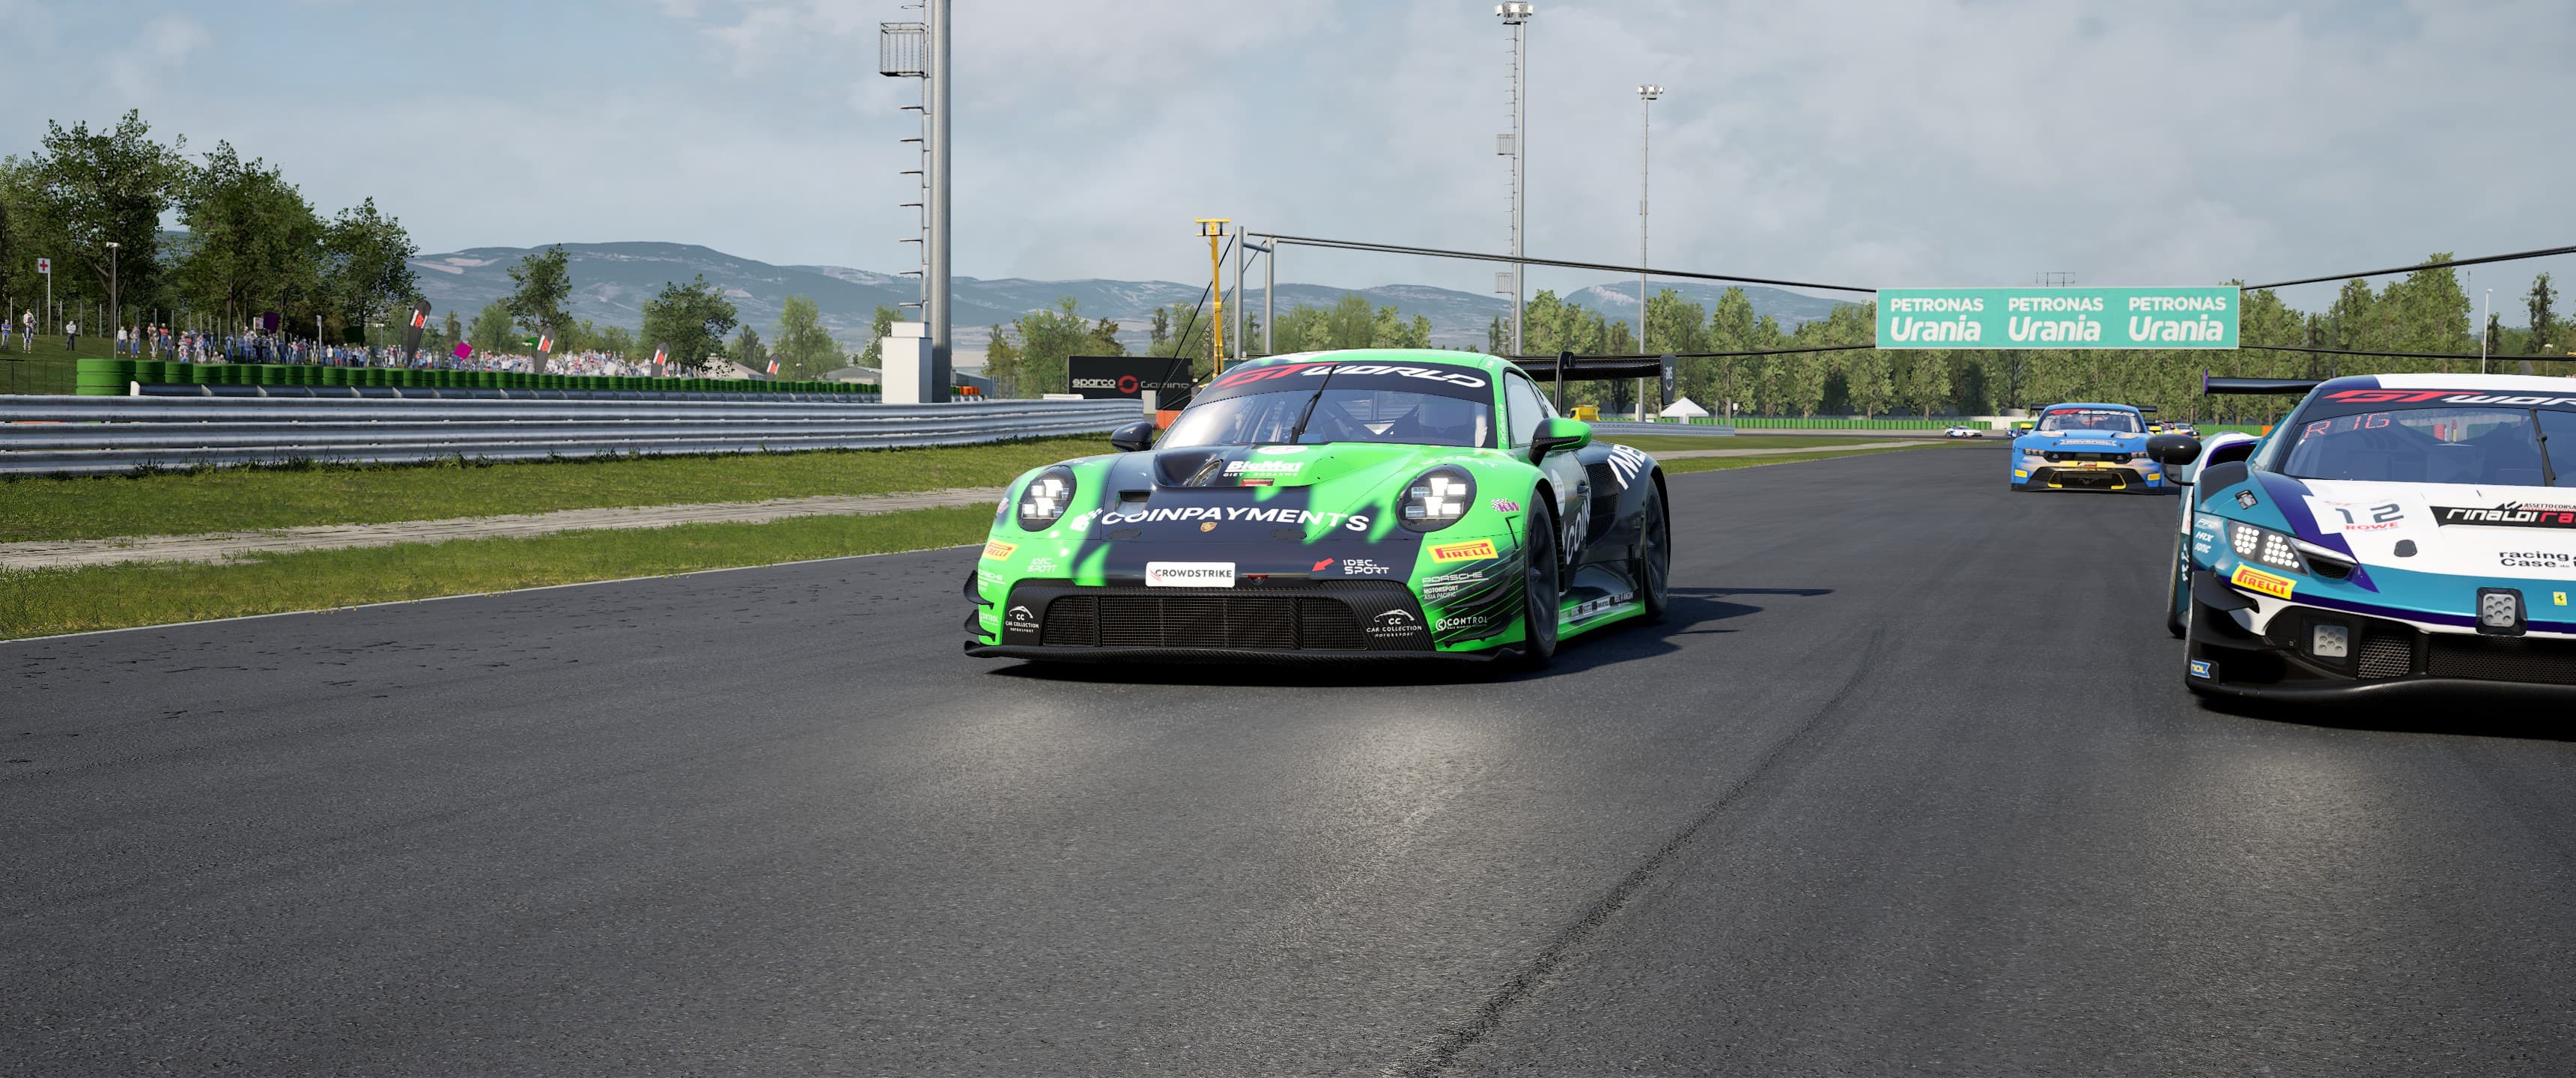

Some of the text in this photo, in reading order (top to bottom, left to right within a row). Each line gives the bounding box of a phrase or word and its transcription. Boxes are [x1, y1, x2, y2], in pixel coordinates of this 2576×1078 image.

[1891, 297, 1984, 312] PETRONAS
[2008, 297, 2103, 312] PETRONAS
[2129, 296, 2226, 311] PETRONAS
[1890, 314, 1981, 342] Urania
[2008, 314, 2102, 342] Urania
[2129, 314, 2224, 342] Urania
[1301, 365, 1486, 388] WORLD
[1101, 507, 1370, 532] COINPAYMENTS
[2335, 503, 2405, 524] 12
[2539, 512, 2576, 524] ra
[2345, 523, 2399, 531] ROWE
[1434, 543, 1492, 559] PIRELLI
[2499, 551, 2569, 562] racing
[1344, 566, 1390, 575] SPORT
[2500, 558, 2556, 568] Case
[1155, 568, 1233, 579] CROWDSTRIKE
[1421, 571, 1483, 583] PORSCHE
[1424, 585, 1459, 594] MOTORSPORT
[2238, 569, 2289, 595] PIRELLI
[1447, 616, 1488, 627] CONTROL
